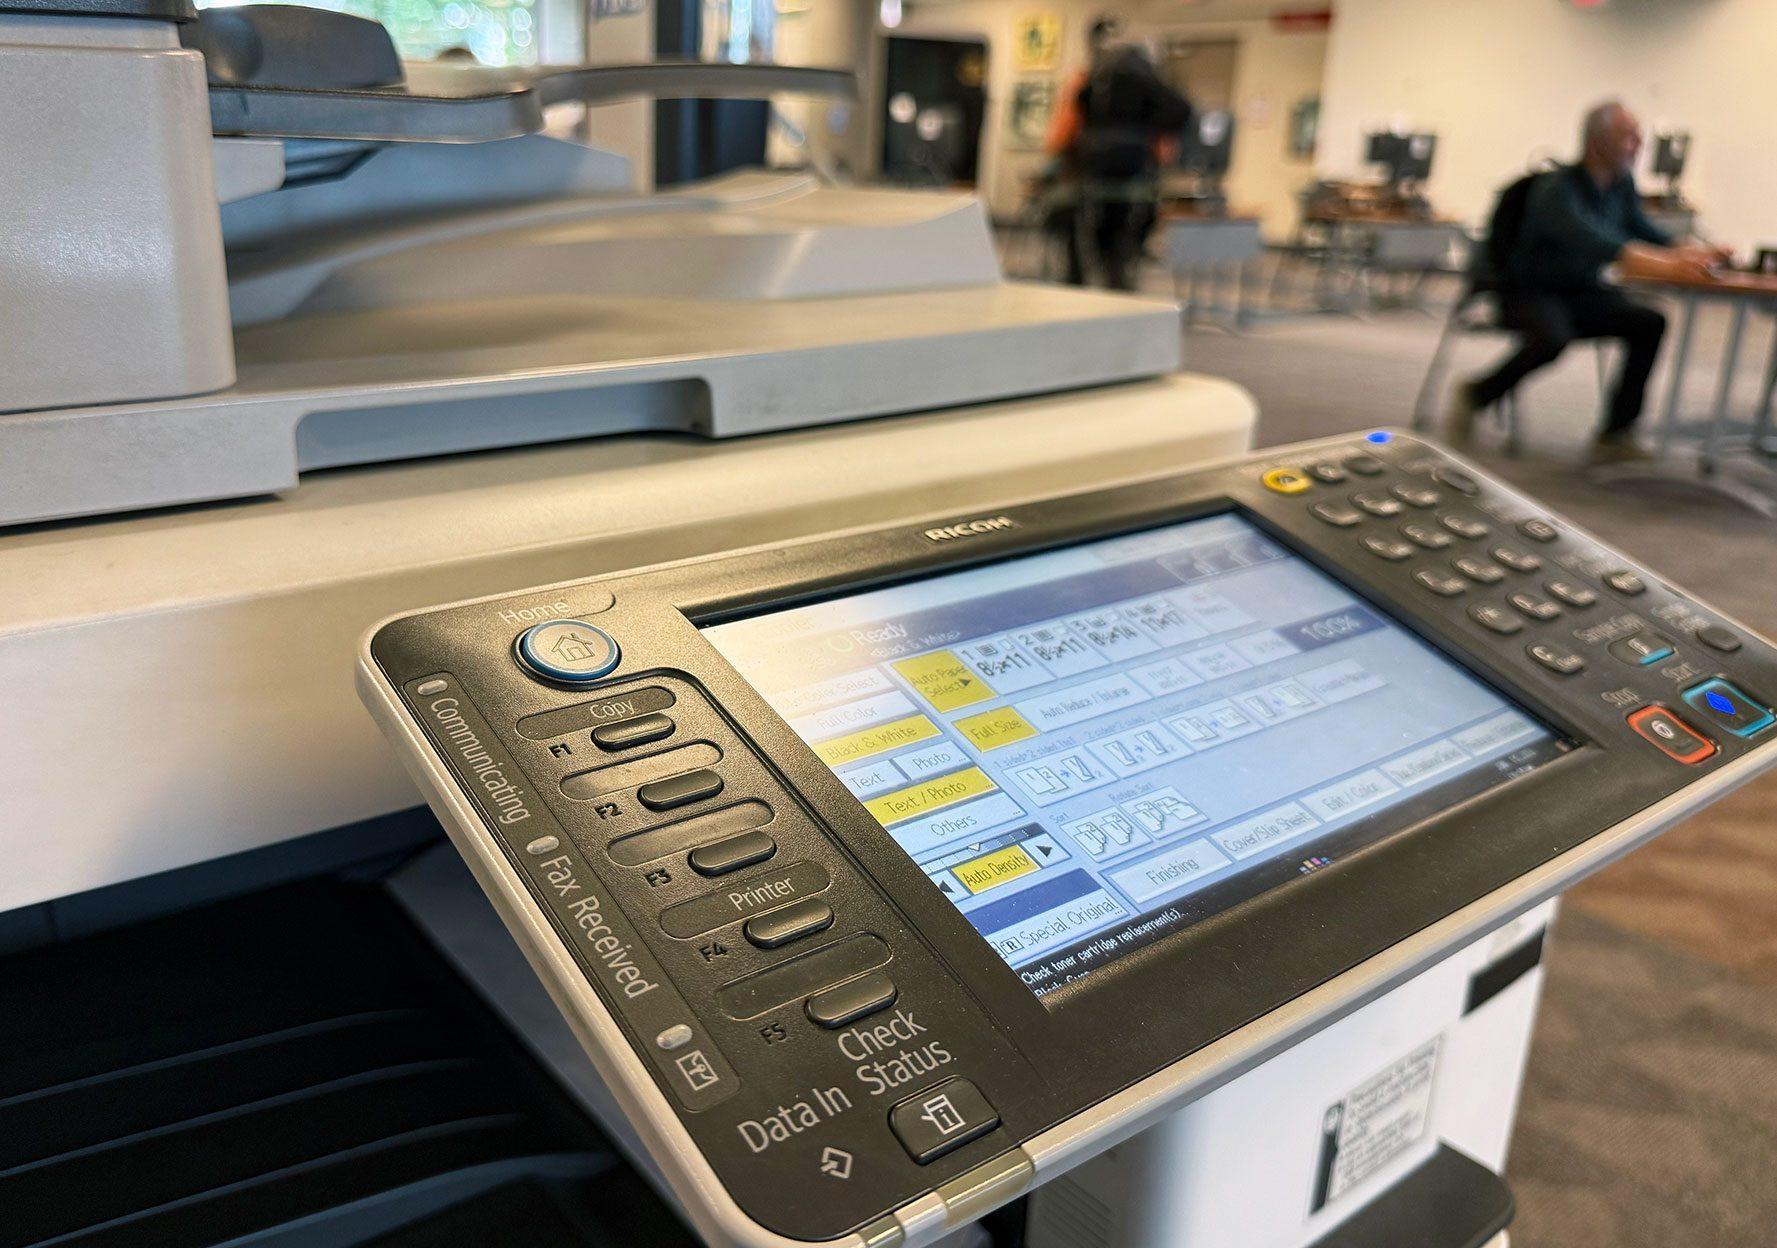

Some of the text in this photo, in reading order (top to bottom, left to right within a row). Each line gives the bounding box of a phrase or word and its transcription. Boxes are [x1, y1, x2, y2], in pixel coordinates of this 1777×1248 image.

[925, 516, 1015, 543] RICOH
[499, 600, 570, 625] Home
[851, 622, 908, 647] Ready
[1018, 634, 1034, 645] 2
[961, 649, 974, 660] 1
[911, 664, 969, 687] Auto Paper
[923, 678, 963, 697] Select
[590, 697, 635, 720] Copy
[816, 706, 878, 730] Full Color
[970, 717, 1023, 741] Full Size
[548, 744, 574, 759] F1
[825, 725, 918, 760] Black & White
[429, 697, 533, 825] Communicating
[912, 751, 952, 772] Photo
[850, 770, 886, 790] Text
[883, 793, 921, 816] Text
[927, 780, 968, 802] Photo
[595, 802, 624, 821] F2
[1049, 812, 1069, 824] Sort
[930, 813, 978, 838] Others
[1222, 812, 1309, 852] Cover/Slip Sheet
[962, 854, 1031, 888] Auto Density
[1146, 857, 1200, 886] Finishing
[726, 877, 796, 912] Printer
[540, 855, 659, 999] Fax Received
[1019, 897, 1119, 947] Special Original
[700, 943, 729, 963] F4
[1020, 965, 1054, 985] Check
[1050, 954, 1077, 972] toner
[1077, 937, 1119, 962] cartridge
[759, 1023, 790, 1046] F5
[836, 1010, 928, 1063] Check
[855, 1038, 953, 1097] Status
[736, 1083, 854, 1155] Data In
